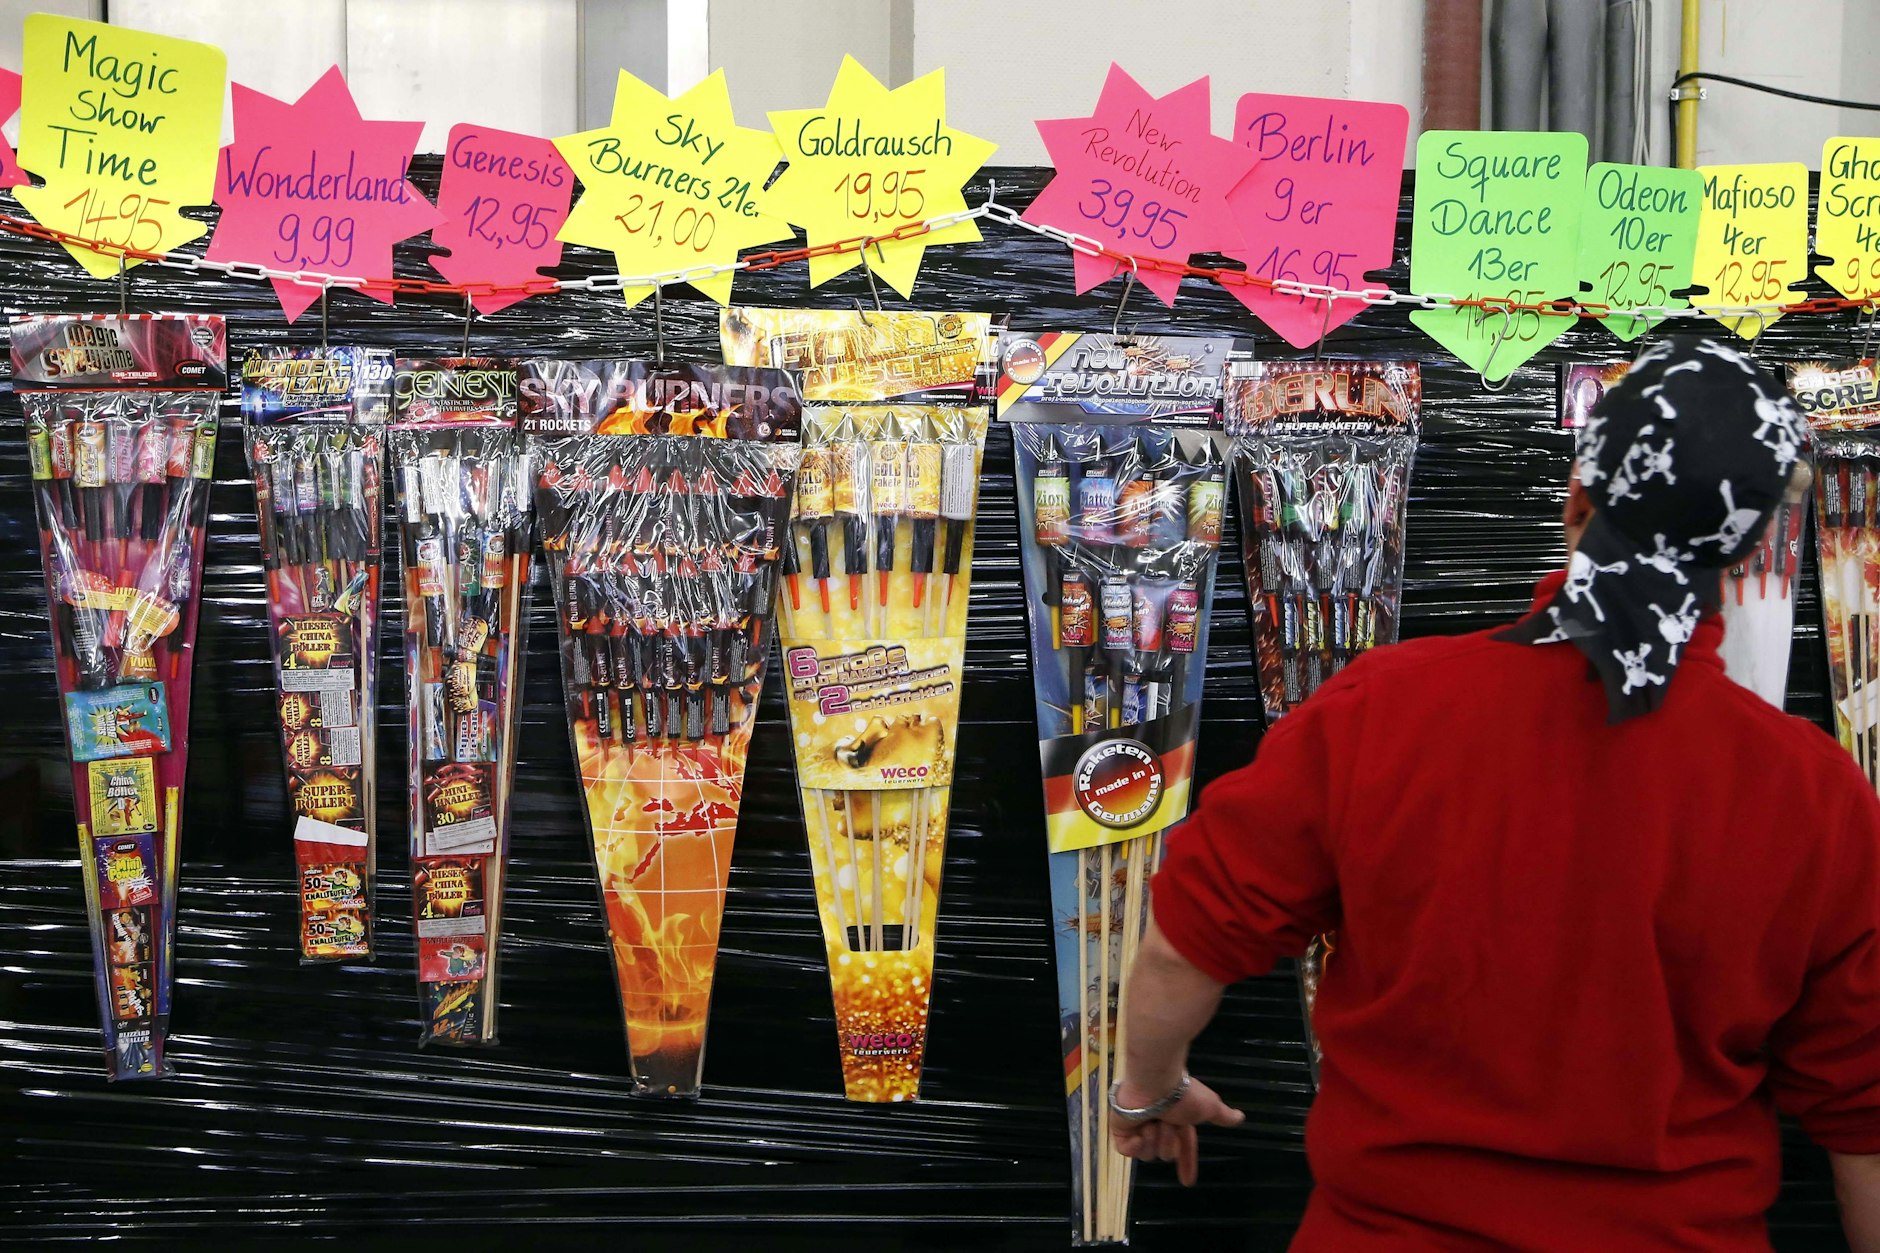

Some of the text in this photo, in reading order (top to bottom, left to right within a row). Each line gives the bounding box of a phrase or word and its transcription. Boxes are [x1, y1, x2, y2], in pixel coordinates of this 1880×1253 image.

[64, 31, 178, 98] Magic
[69, 90, 166, 134] Show
[655, 114, 725, 165] Sky
[798, 116, 952, 157] Goldrausch
[1125, 109, 1182, 152] New
[1247, 112, 1376, 166] Berlin
[48, 125, 158, 186] Time
[452, 135, 564, 188] Genesis
[588, 137, 711, 200] Burners
[1081, 127, 1202, 204] Revolution
[1437, 142, 1562, 202] Square
[226, 146, 411, 206] Wonderland
[1598, 169, 1689, 214] Odeon
[834, 169, 926, 224] 19,95
[1078, 179, 1189, 250] 39,95
[1703, 174, 1796, 220] Mafioso
[63, 188, 171, 252] 14,95
[463, 196, 558, 250] 12,95
[614, 194, 716, 253] 21,00
[1430, 199, 1552, 236] Dance
[1610, 217, 1673, 253] 10er
[274, 213, 355, 270] 9,99
[1723, 223, 1768, 256] 4er
[1256, 246, 1358, 305] 16,95
[1467, 247, 1540, 283] 13er
[1599, 261, 1676, 311] 12,95
[1714, 260, 1788, 307] 12,95
[248, 359, 351, 378] WONDER-
[1006, 342, 1042, 362] Raketen
[1013, 359, 1030, 367] made
[1070, 347, 1127, 370] new
[182, 367, 206, 375] COMET
[287, 376, 350, 395] LAND
[362, 364, 393, 380] 130
[1042, 371, 1218, 399] revolution
[519, 377, 602, 416] SKY
[607, 377, 798, 419] BURNERS
[1243, 372, 1407, 423] BERLIN
[524, 419, 538, 431] 21
[539, 419, 592, 432] ROCKETS
[1276, 421, 1372, 431] 9 SUPER-RAKETEN
[1036, 489, 1064, 507] Zion
[283, 652, 298, 669] 4
[788, 647, 818, 679] 6
[819, 685, 851, 717] 2
[849, 664, 950, 694] verschiedenen
[110, 775, 135, 787] China
[880, 766, 929, 780] weco
[884, 777, 925, 785] feuerwerk
[1079, 743, 1152, 791] Raketen
[1095, 769, 1146, 797] made in
[295, 796, 348, 811] BÖLLER
[303, 784, 351, 797] SUPER-
[1087, 773, 1162, 823] Germany
[436, 811, 455, 825] 30
[117, 843, 136, 851] COMET
[109, 868, 143, 882] Power
[304, 877, 321, 889] 50
[421, 901, 434, 918] 4
[308, 923, 325, 935] 50
[118, 1030, 150, 1038] BLIZZARD
[850, 1033, 913, 1048] weco
[854, 1047, 910, 1056] feuerwerk
